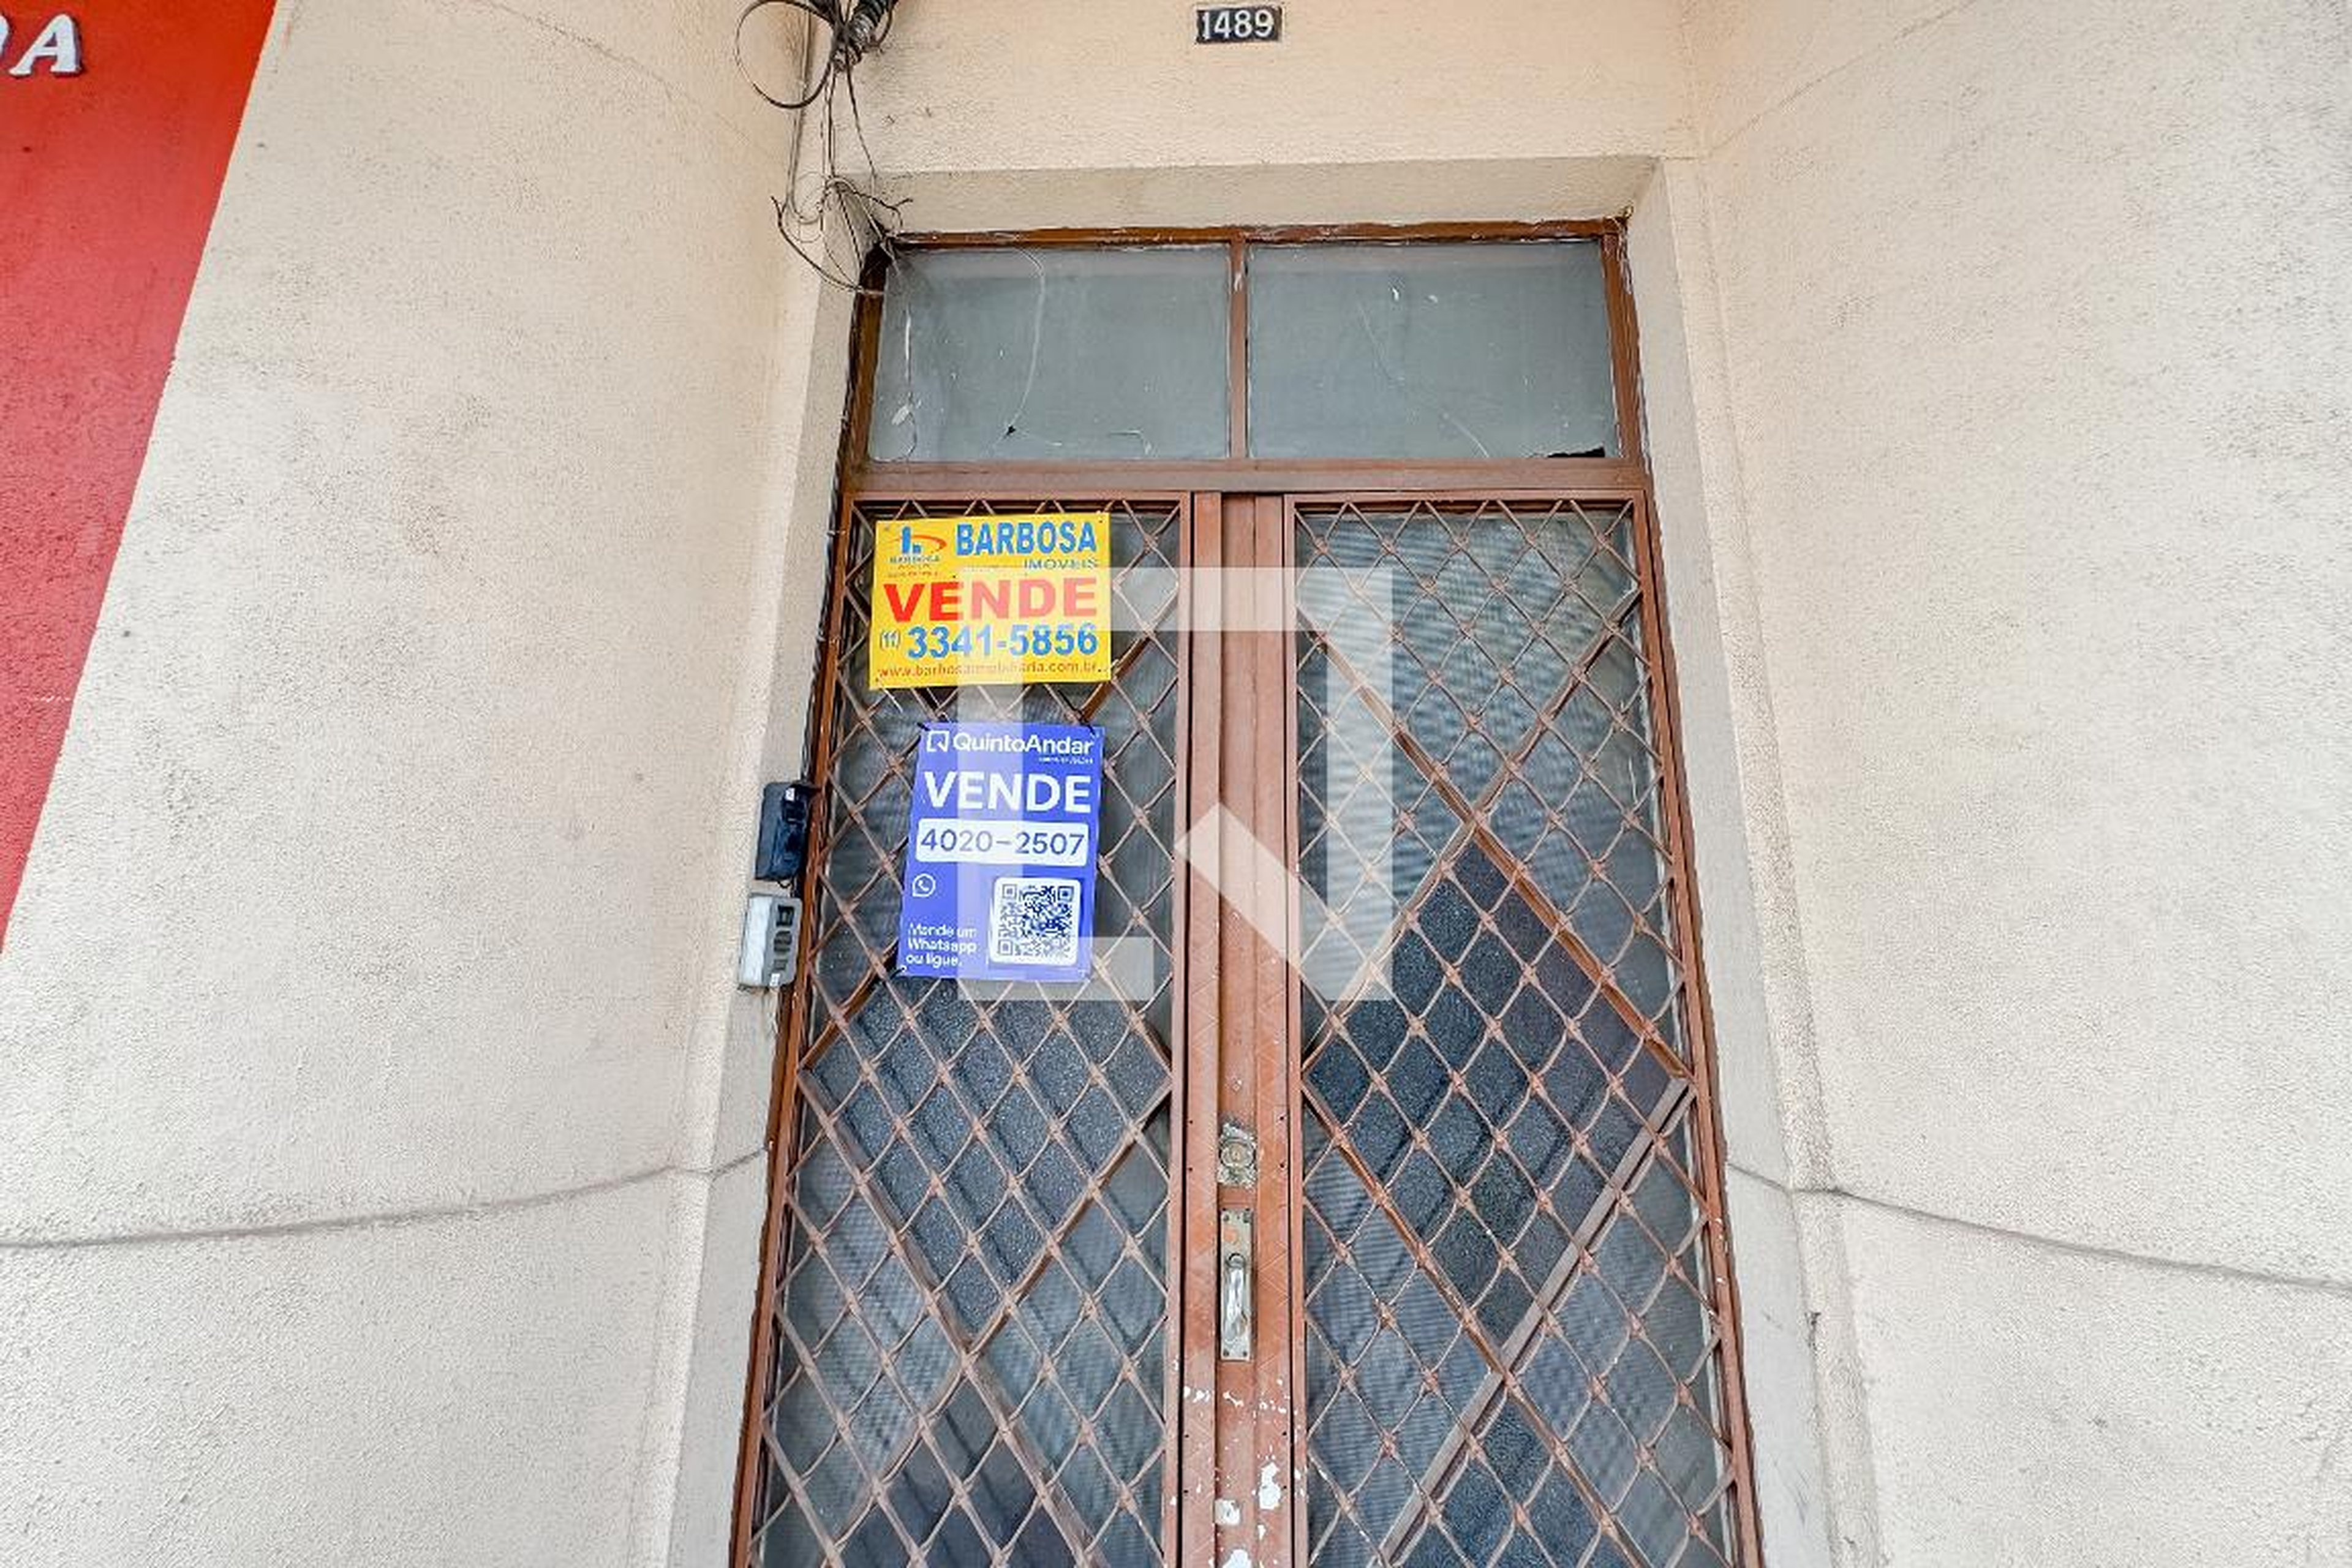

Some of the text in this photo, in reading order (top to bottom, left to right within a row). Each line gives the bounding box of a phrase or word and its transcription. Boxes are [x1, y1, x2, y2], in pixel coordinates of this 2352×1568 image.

[1202, 9, 1274, 39] 1489
[956, 522, 1097, 556] BARBOSA
[883, 577, 1098, 622] VENDE
[908, 624, 1098, 658] 3341-5856
[953, 733, 1093, 755] QuintoAndar
[924, 771, 1091, 813] VENDE
[921, 828, 1085, 856] 4020-2507
[906, 954, 924, 964] ou
[908, 938, 976, 954] Whatsapp
